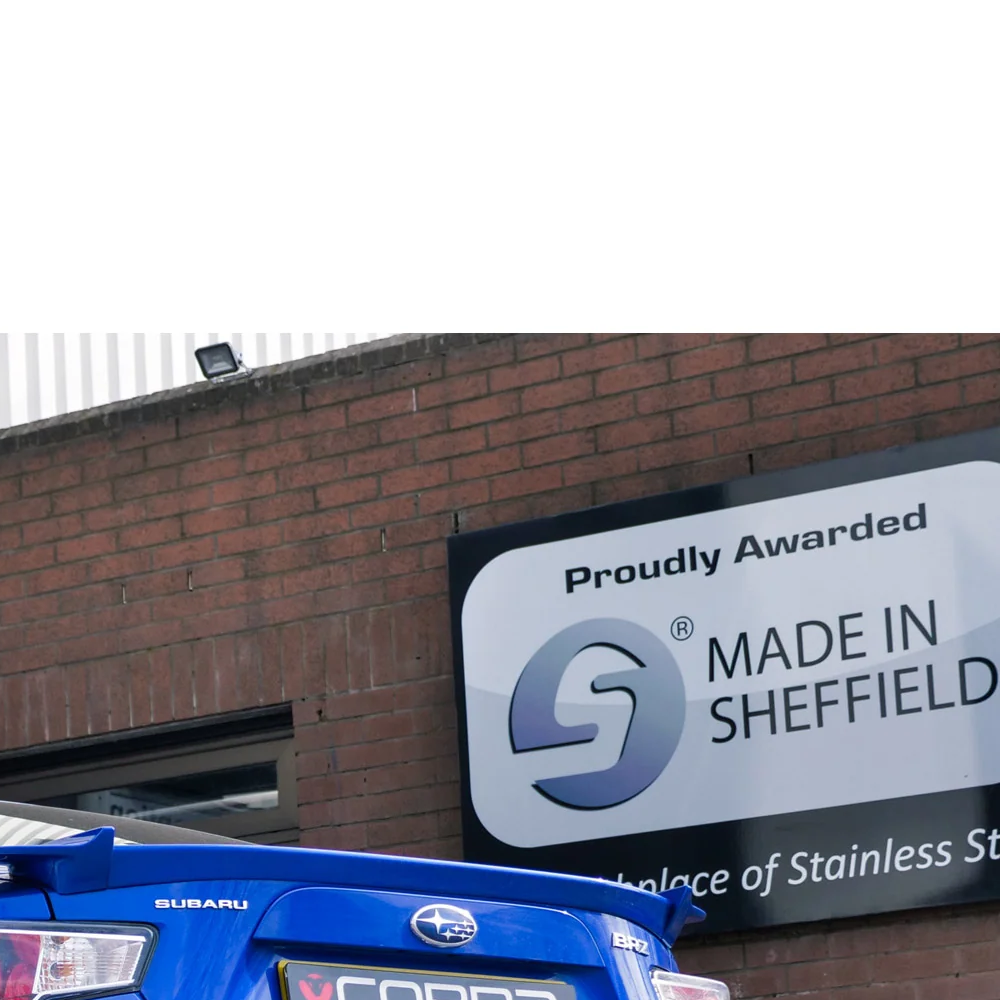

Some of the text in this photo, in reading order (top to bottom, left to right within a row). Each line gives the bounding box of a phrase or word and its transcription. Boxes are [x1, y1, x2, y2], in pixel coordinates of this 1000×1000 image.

[565, 502, 927, 593] Proudly Awarded
[708, 599, 938, 682] MADE IN
[710, 656, 999, 744] SHEFFIELD
[741, 852, 781, 897] of
[787, 838, 952, 886] Stainless
[154, 899, 248, 910] SUBARU
[611, 932, 649, 957] BRZ
